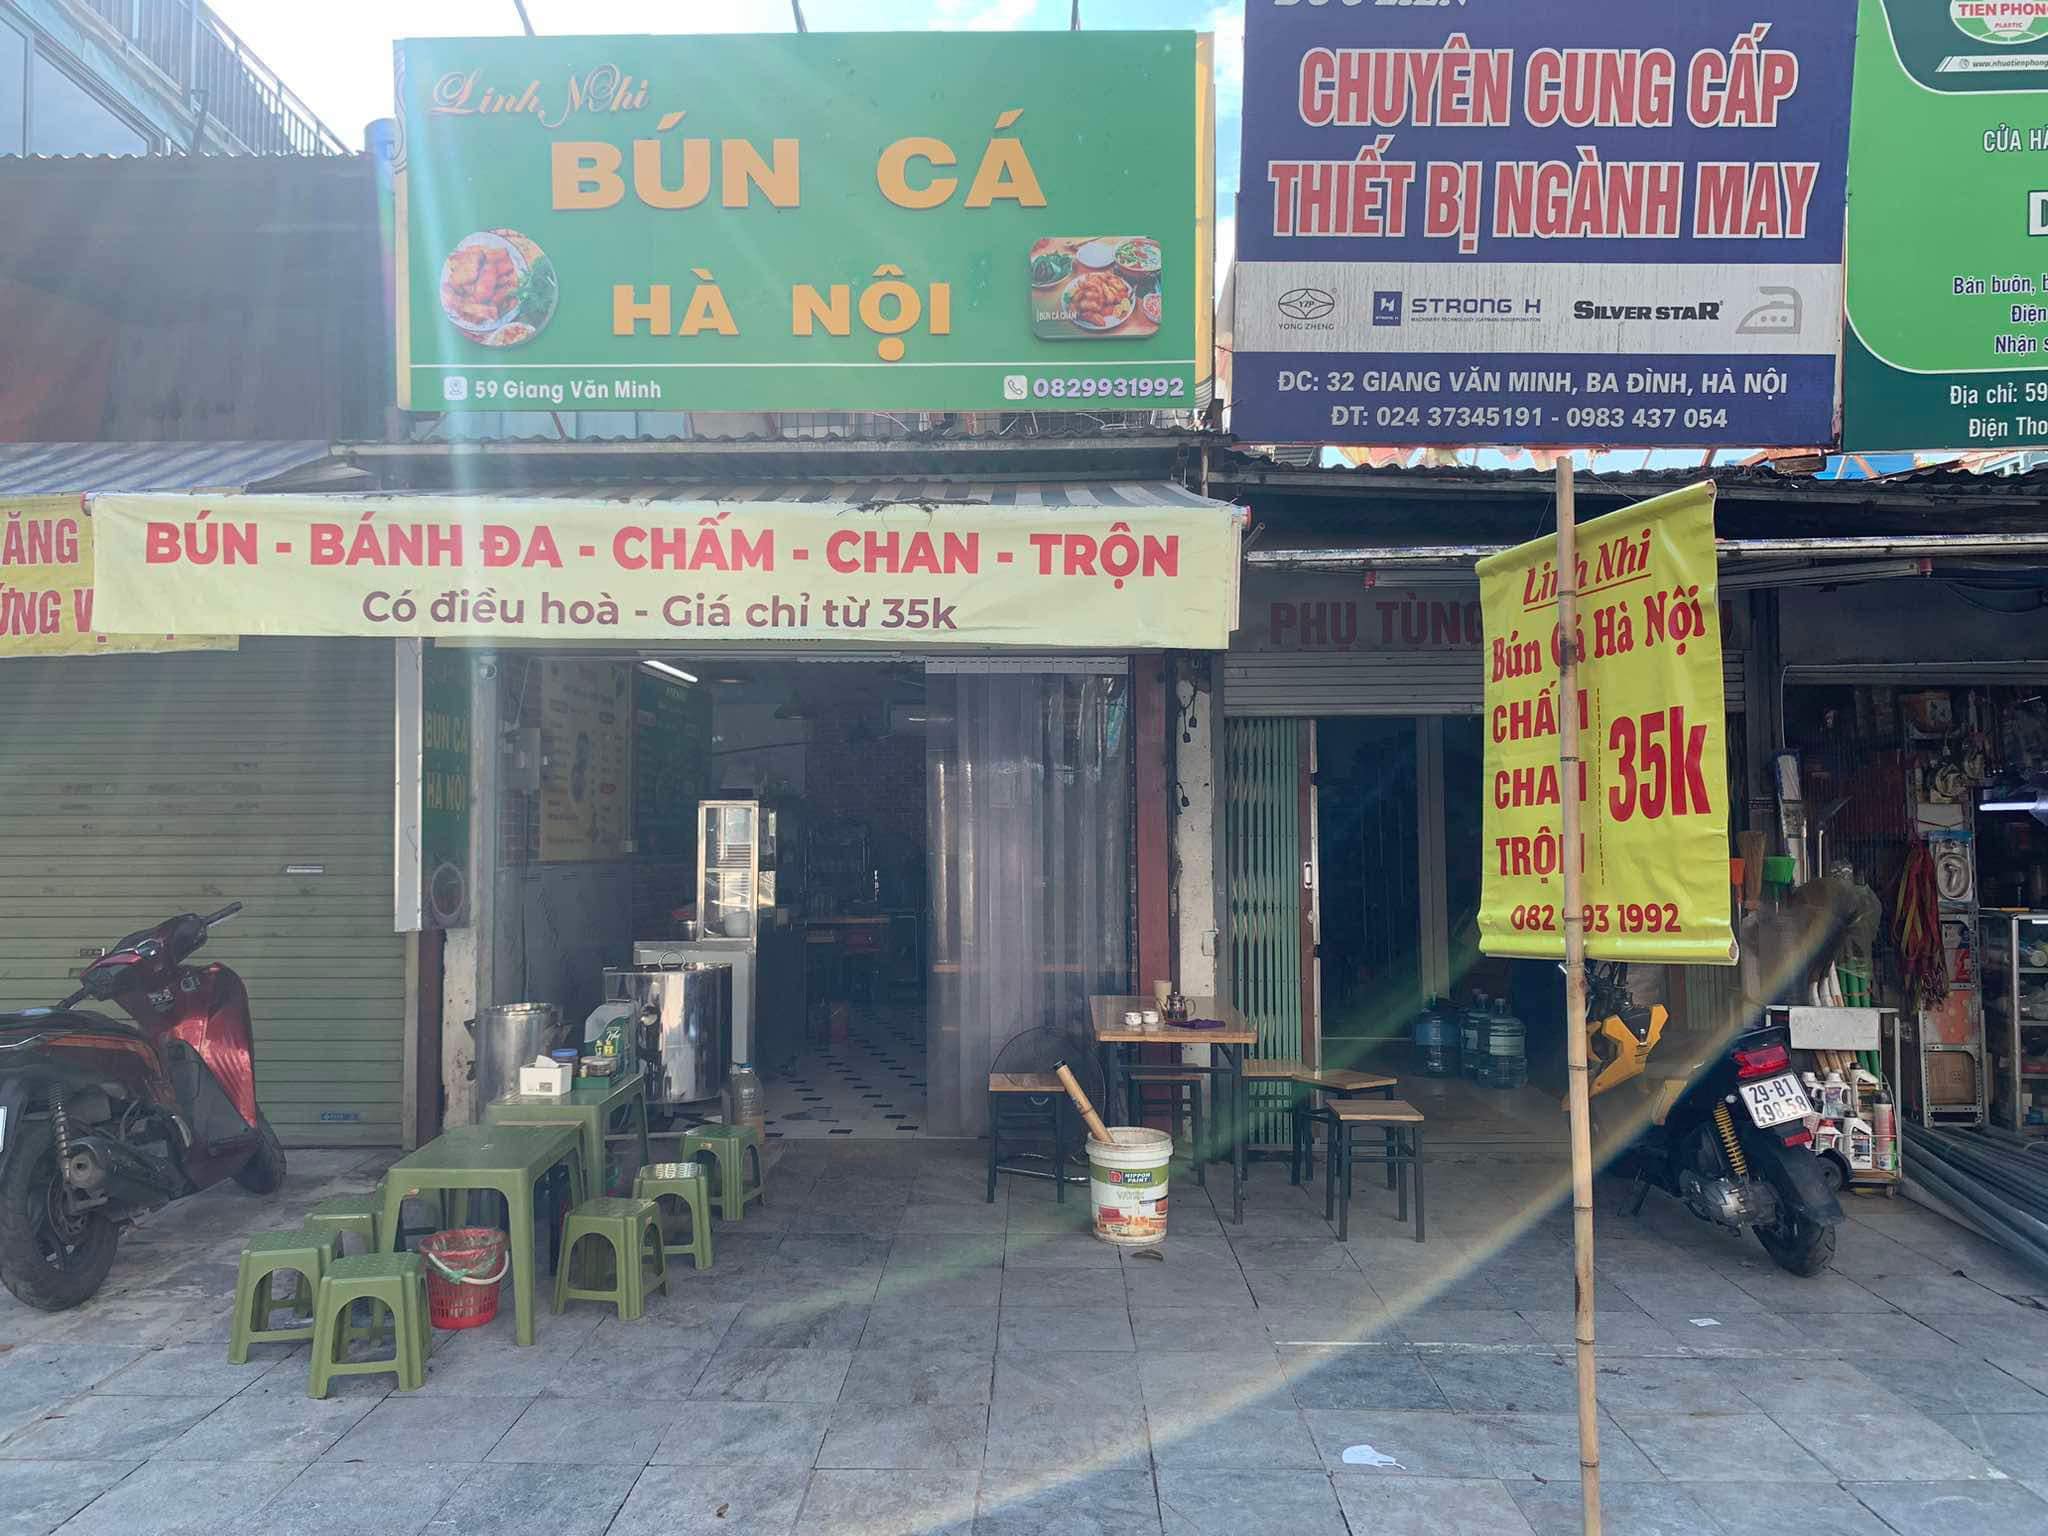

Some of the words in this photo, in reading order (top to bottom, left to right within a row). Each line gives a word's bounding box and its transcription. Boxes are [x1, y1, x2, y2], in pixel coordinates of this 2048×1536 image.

[1959, 4, 1997, 16] TIEN
[2000, 4, 2048, 16] PHON
[430, 67, 543, 113] Linh
[1300, 33, 1513, 126] CHUYÊN
[1524, 48, 1675, 127] CUNG
[1687, 23, 1798, 127] CẤP
[1983, 123, 2022, 152] CỬA
[551, 112, 799, 211] BÚN
[876, 109, 1047, 208] CÁ
[1268, 134, 1415, 236] THIẾT
[1424, 161, 1482, 254] BỊ
[1493, 146, 1683, 238] NGÀNH
[1693, 162, 1819, 238] MAY
[1953, 276, 1985, 295] Bán
[612, 268, 739, 336] HÀ
[792, 264, 950, 361] NỘI
[1411, 298, 1512, 313] STRONG
[1525, 298, 1541, 313] H
[1573, 300, 1652, 319] SILVER
[1655, 302, 1719, 320] STAR
[2011, 304, 2047, 325] Điện
[1995, 335, 2037, 356] Nhận
[474, 381, 498, 398] 59
[503, 380, 564, 403] Giang
[570, 379, 608, 398] Văn
[614, 380, 662, 398] Minh
[1033, 377, 1185, 398] 0829931992
[1278, 371, 1319, 392] ĐC:
[1326, 372, 1354, 392] 32
[1362, 371, 1441, 393] GIANG
[1447, 366, 1501, 393] VĂN
[1507, 371, 1579, 397] MINH,
[1586, 372, 1619, 393] BA
[1625, 368, 1693, 398] ĐÌNH,
[1701, 368, 1736, 394] HÀ
[1741, 368, 1788, 400] NỘI
[1950, 385, 1978, 408] Địa
[1986, 382, 2018, 403] chỉ:
[2025, 382, 2048, 402] 59
[1331, 406, 1369, 427] ĐT:
[1376, 407, 1421, 427] 024
[1426, 406, 1543, 428] 37345191
[1566, 407, 1626, 428] 0983
[1633, 408, 1677, 428] 437
[1683, 408, 1728, 429] 054
[1969, 418, 2008, 441] Điện
[2, 511, 79, 565] ĂNG
[145, 510, 258, 565] BÚN
[310, 513, 462, 567] BÁNH
[480, 525, 564, 569] ĐA
[612, 511, 774, 572] CHẤM
[826, 530, 980, 575] CHAN
[1029, 521, 1179, 589] TRỘN
[1522, 553, 1588, 606] Lih
[1595, 528, 1651, 584] Nhi
[362, 591, 417, 622] Có
[430, 587, 525, 625] điều
[541, 591, 620, 625] hoà
[662, 592, 729, 627] Giá
[745, 592, 809, 628] chỉ
[823, 593, 872, 629] từ
[881, 596, 958, 631] 35k
[1269, 601, 1358, 655] PHỤ
[1492, 630, 1542, 683] Bún
[1594, 600, 1634, 659] Hà
[1643, 584, 1705, 656] Nội
[1608, 706, 1712, 823] 35k
[1495, 825, 1585, 884] TRỘ
[1510, 904, 1556, 931] 082
[1562, 904, 1609, 933] 93
[1617, 903, 1682, 933] 1992
[1748, 1078, 1795, 1104] 29-B1
